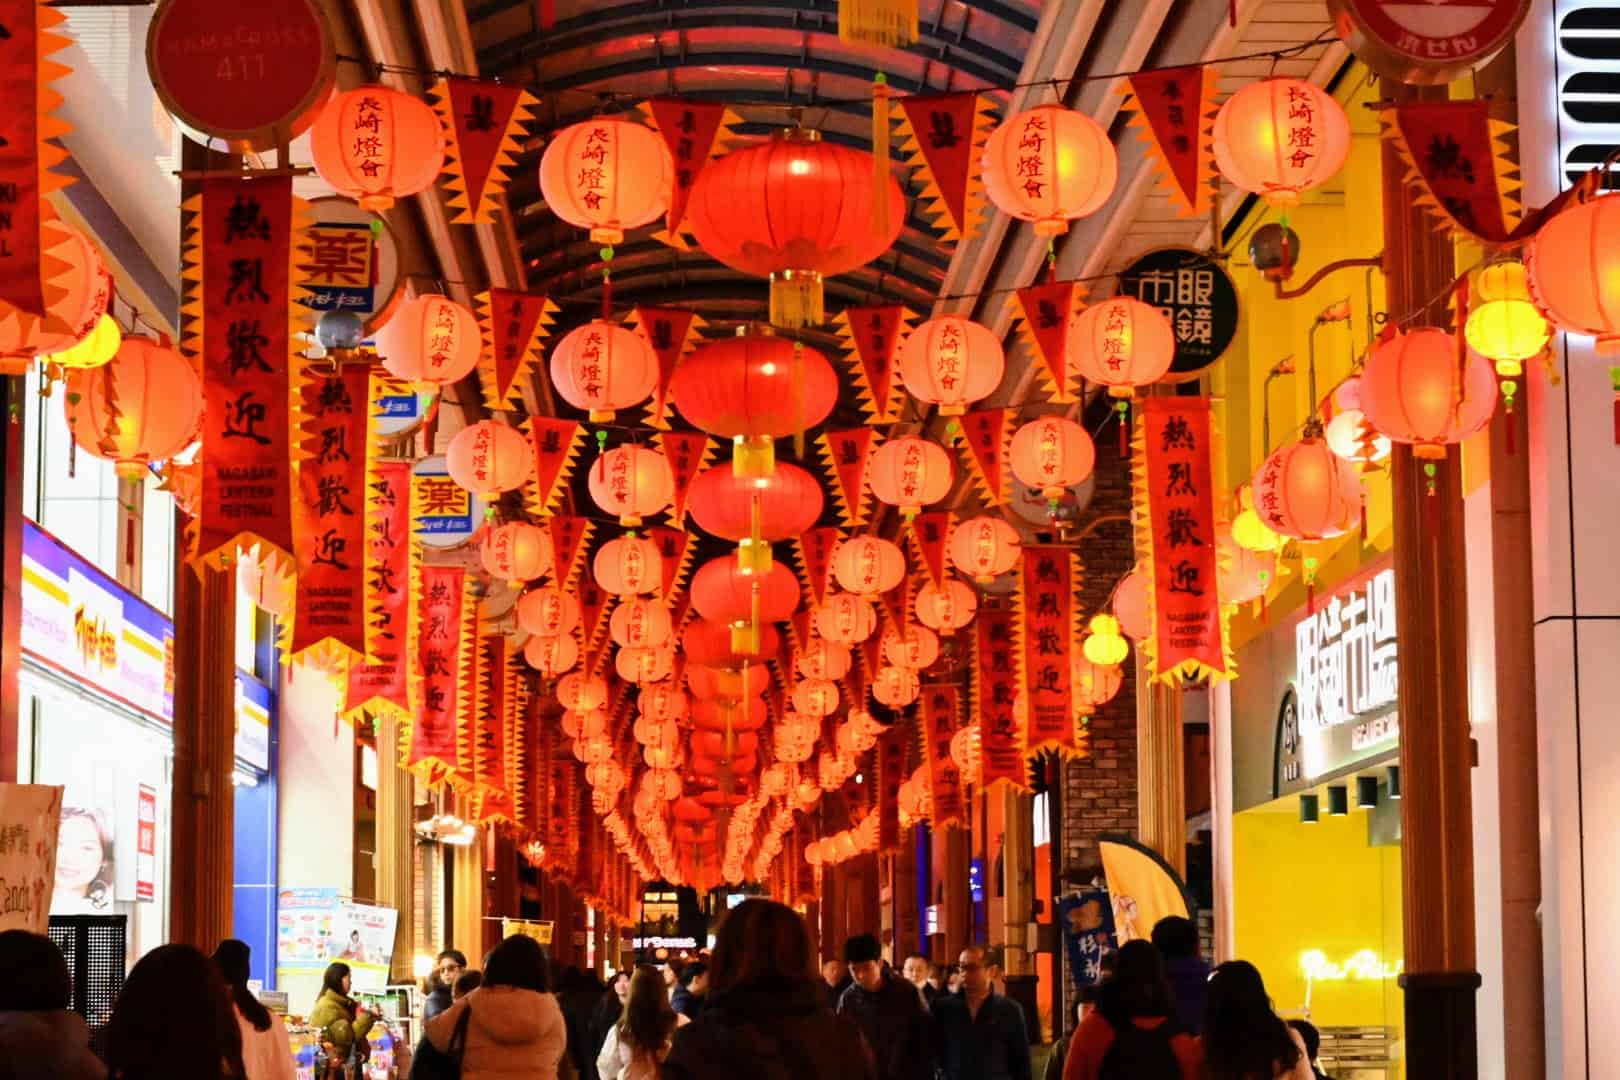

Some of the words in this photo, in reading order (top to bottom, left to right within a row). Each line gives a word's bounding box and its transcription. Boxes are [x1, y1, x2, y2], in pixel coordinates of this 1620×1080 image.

[354, 96, 382, 178] 長崎燈會
[577, 128, 611, 211] 長崎燈會
[1016, 115, 1047, 199] 長崎燈會
[1287, 86, 1317, 170] 長崎燈會
[296, 230, 366, 284] 薬
